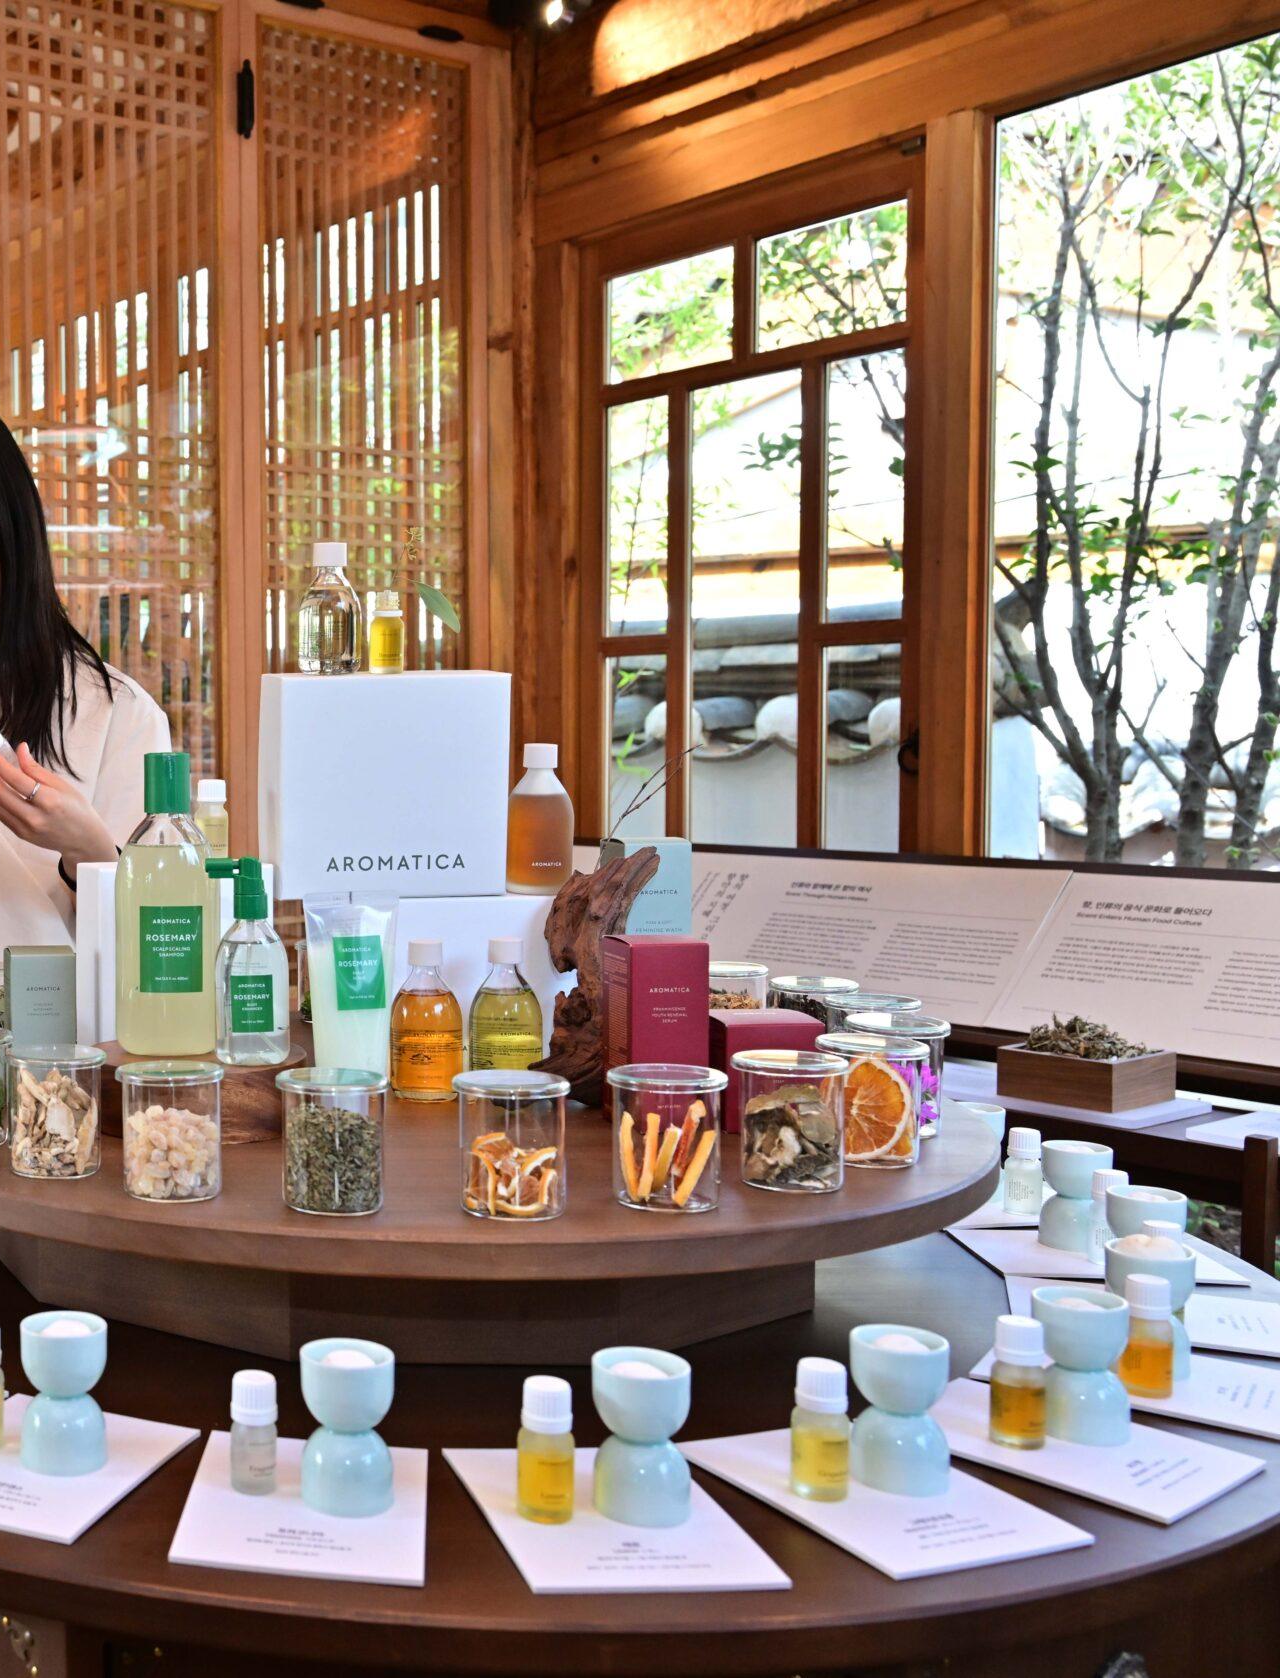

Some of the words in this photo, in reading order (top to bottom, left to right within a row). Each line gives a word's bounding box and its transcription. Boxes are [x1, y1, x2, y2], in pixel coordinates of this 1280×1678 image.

[326, 853, 466, 873] AROMATICA
[145, 934, 197, 942] ROSEMARY
[338, 959, 378, 967] ROSEMARY
